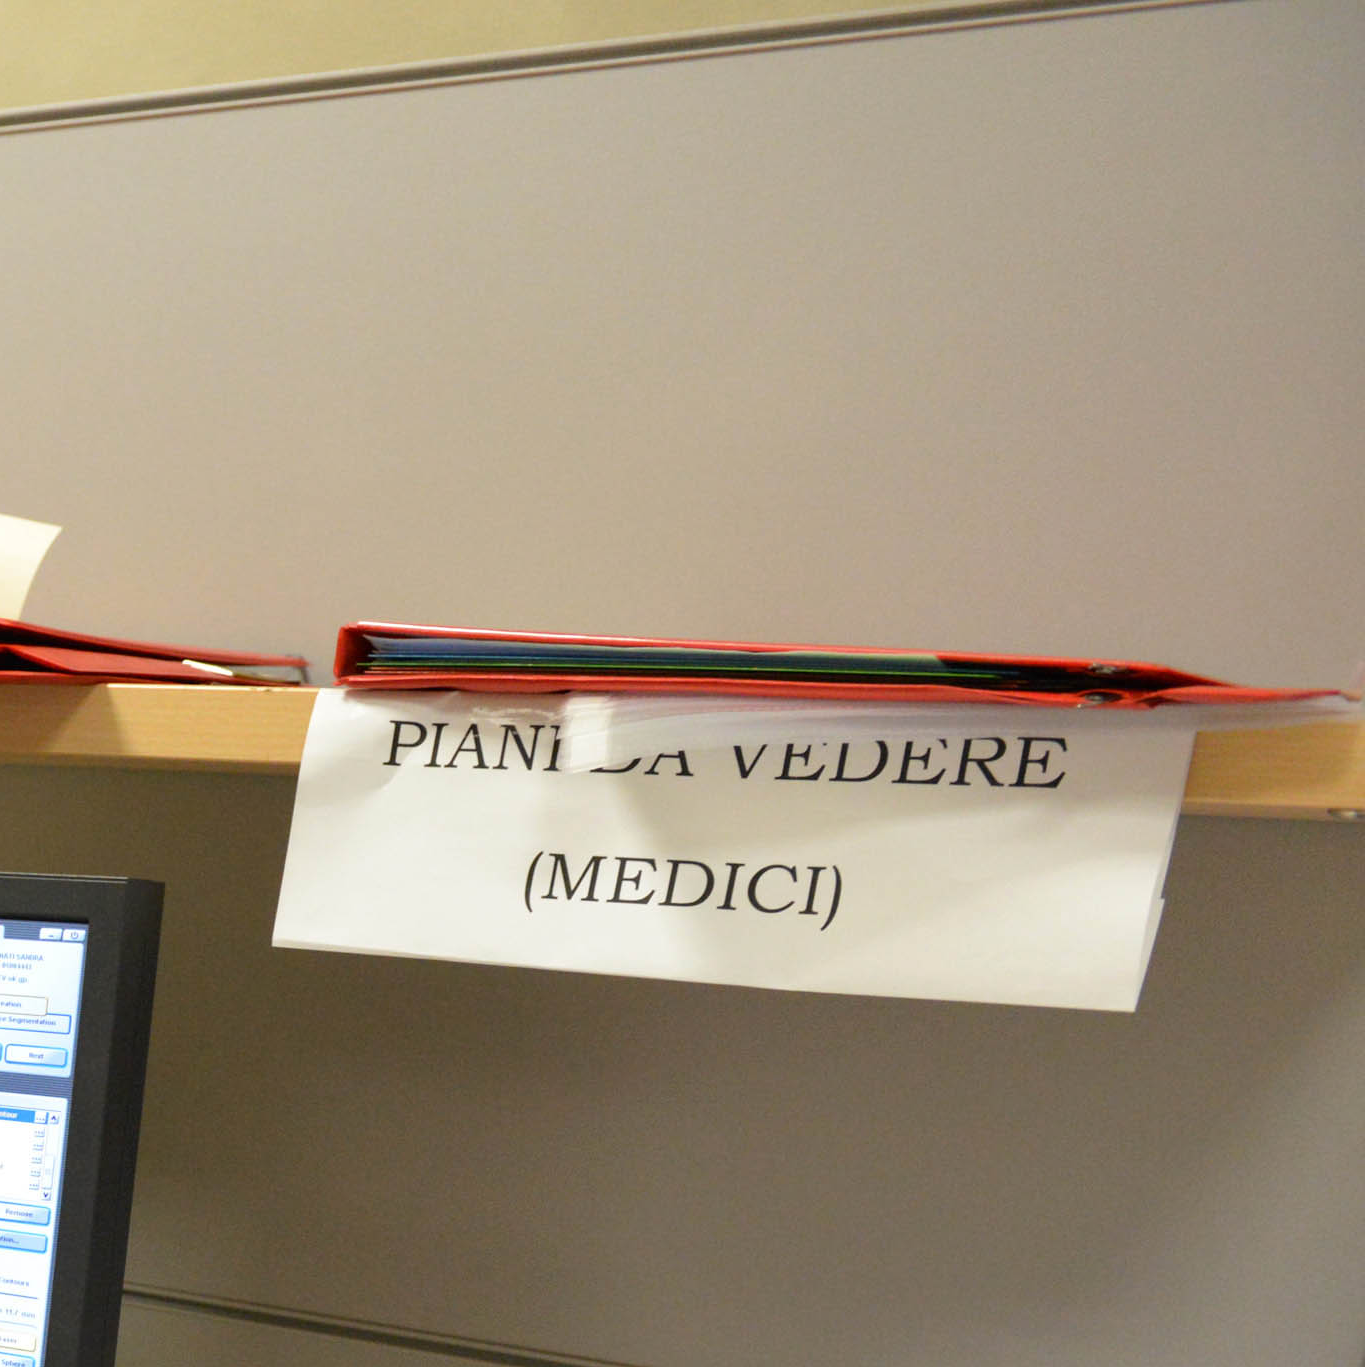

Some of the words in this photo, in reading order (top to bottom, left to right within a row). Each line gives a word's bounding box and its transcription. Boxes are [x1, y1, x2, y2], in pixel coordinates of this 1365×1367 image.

[382, 719, 561, 772] PIANI
[732, 737, 1068, 789] VEDERE
[523, 850, 843, 931] (MEDICI)
[8, 1016, 57, 1028] Segmentation
